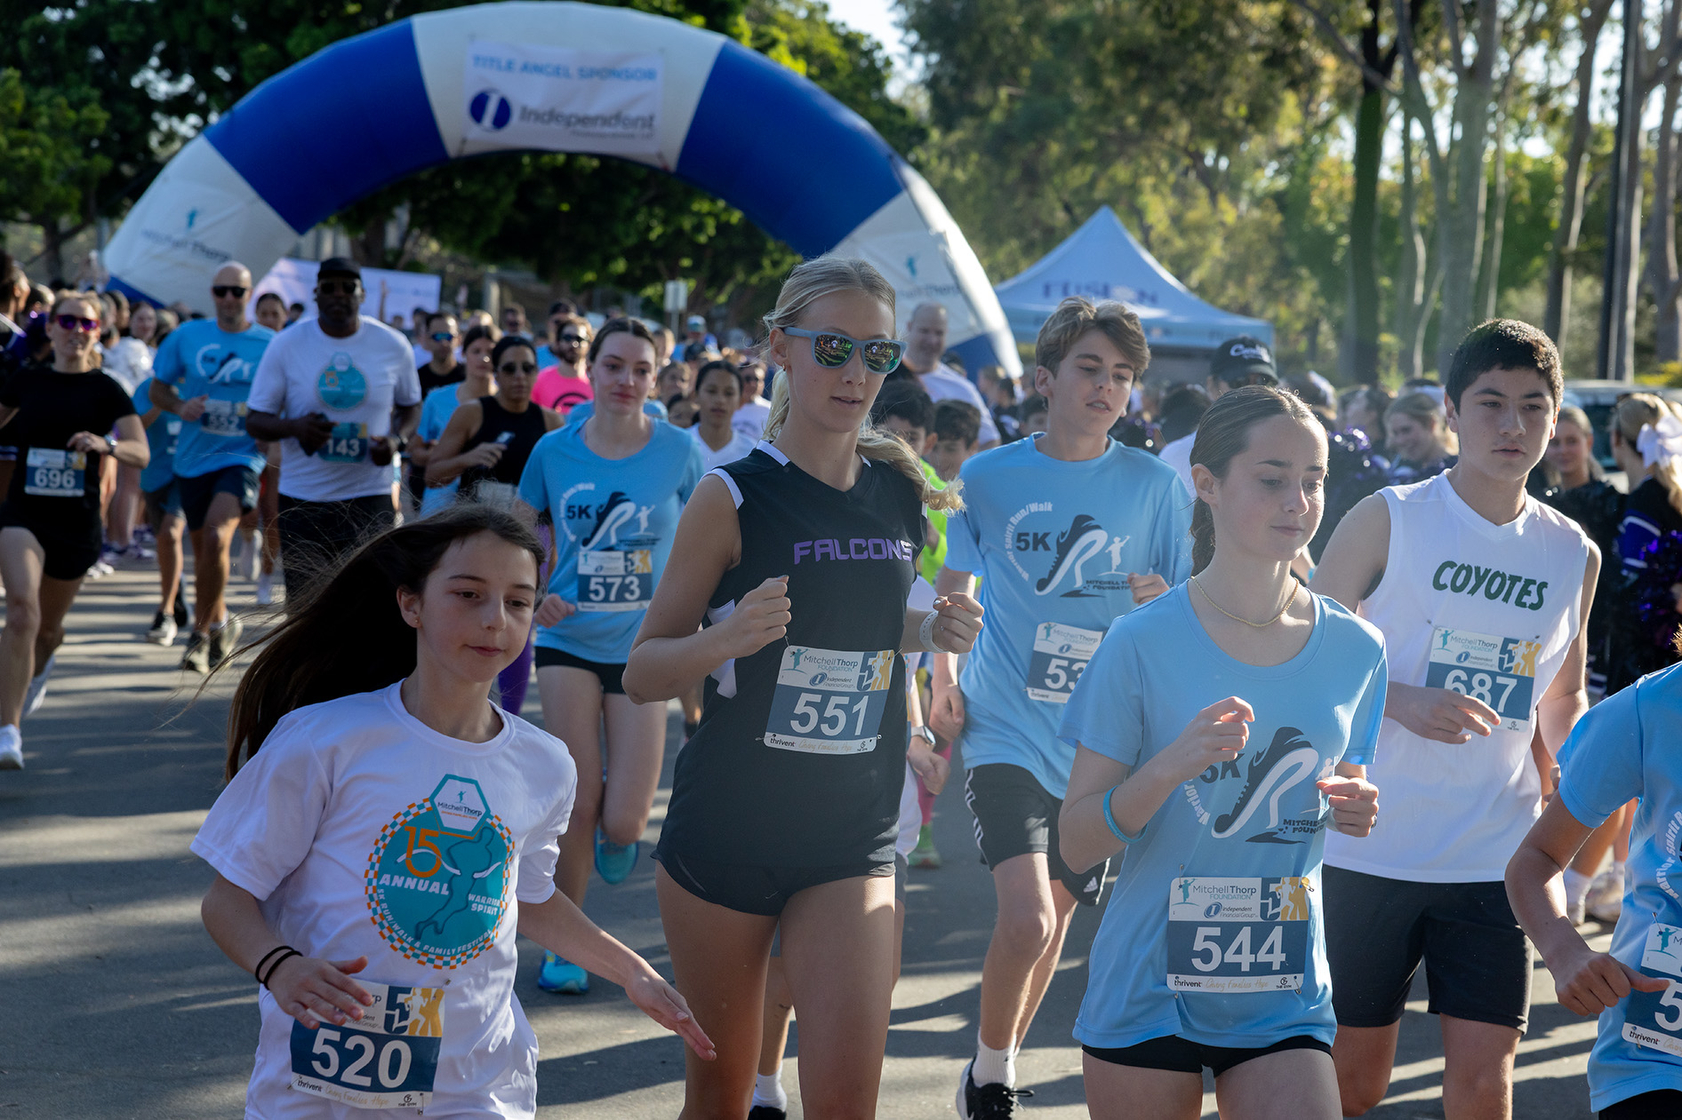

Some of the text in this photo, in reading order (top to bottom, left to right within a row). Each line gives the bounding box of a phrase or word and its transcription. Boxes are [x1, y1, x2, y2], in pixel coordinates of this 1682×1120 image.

[473, 55, 657, 82] TITLE ANGEL SPONSOR
[519, 105, 655, 130] Independent
[327, 438, 360, 457] 143
[34, 468, 76, 489] 696
[566, 504, 592, 520] 5K
[1009, 501, 1053, 525] Run/Walk
[794, 538, 913, 565] FALCONS
[1015, 532, 1052, 552] 5K
[588, 575, 641, 602] 573
[1432, 560, 1548, 611] COYOTES
[817, 664, 853, 673] FOUNDATION
[1044, 657, 1087, 691] 53
[1443, 668, 1518, 714] 687
[789, 692, 870, 737] 551
[769, 737, 796, 747] thrivent
[1198, 753, 1245, 785] 5K
[1183, 783, 1211, 826] Warrior
[1283, 818, 1319, 827] MITCHE
[404, 825, 442, 878] 15
[378, 873, 449, 896] ANNUAL
[470, 902, 498, 916] SPIRIT
[380, 902, 413, 944] RUN/WALK
[422, 944, 456, 956] FAMILY
[456, 929, 492, 952] FESTIVAL
[1191, 925, 1286, 972] 544
[1174, 979, 1202, 988] thrivent
[1629, 1031, 1659, 1046] thrivent
[310, 1027, 412, 1089] 520
[297, 1079, 322, 1093] thrivent
